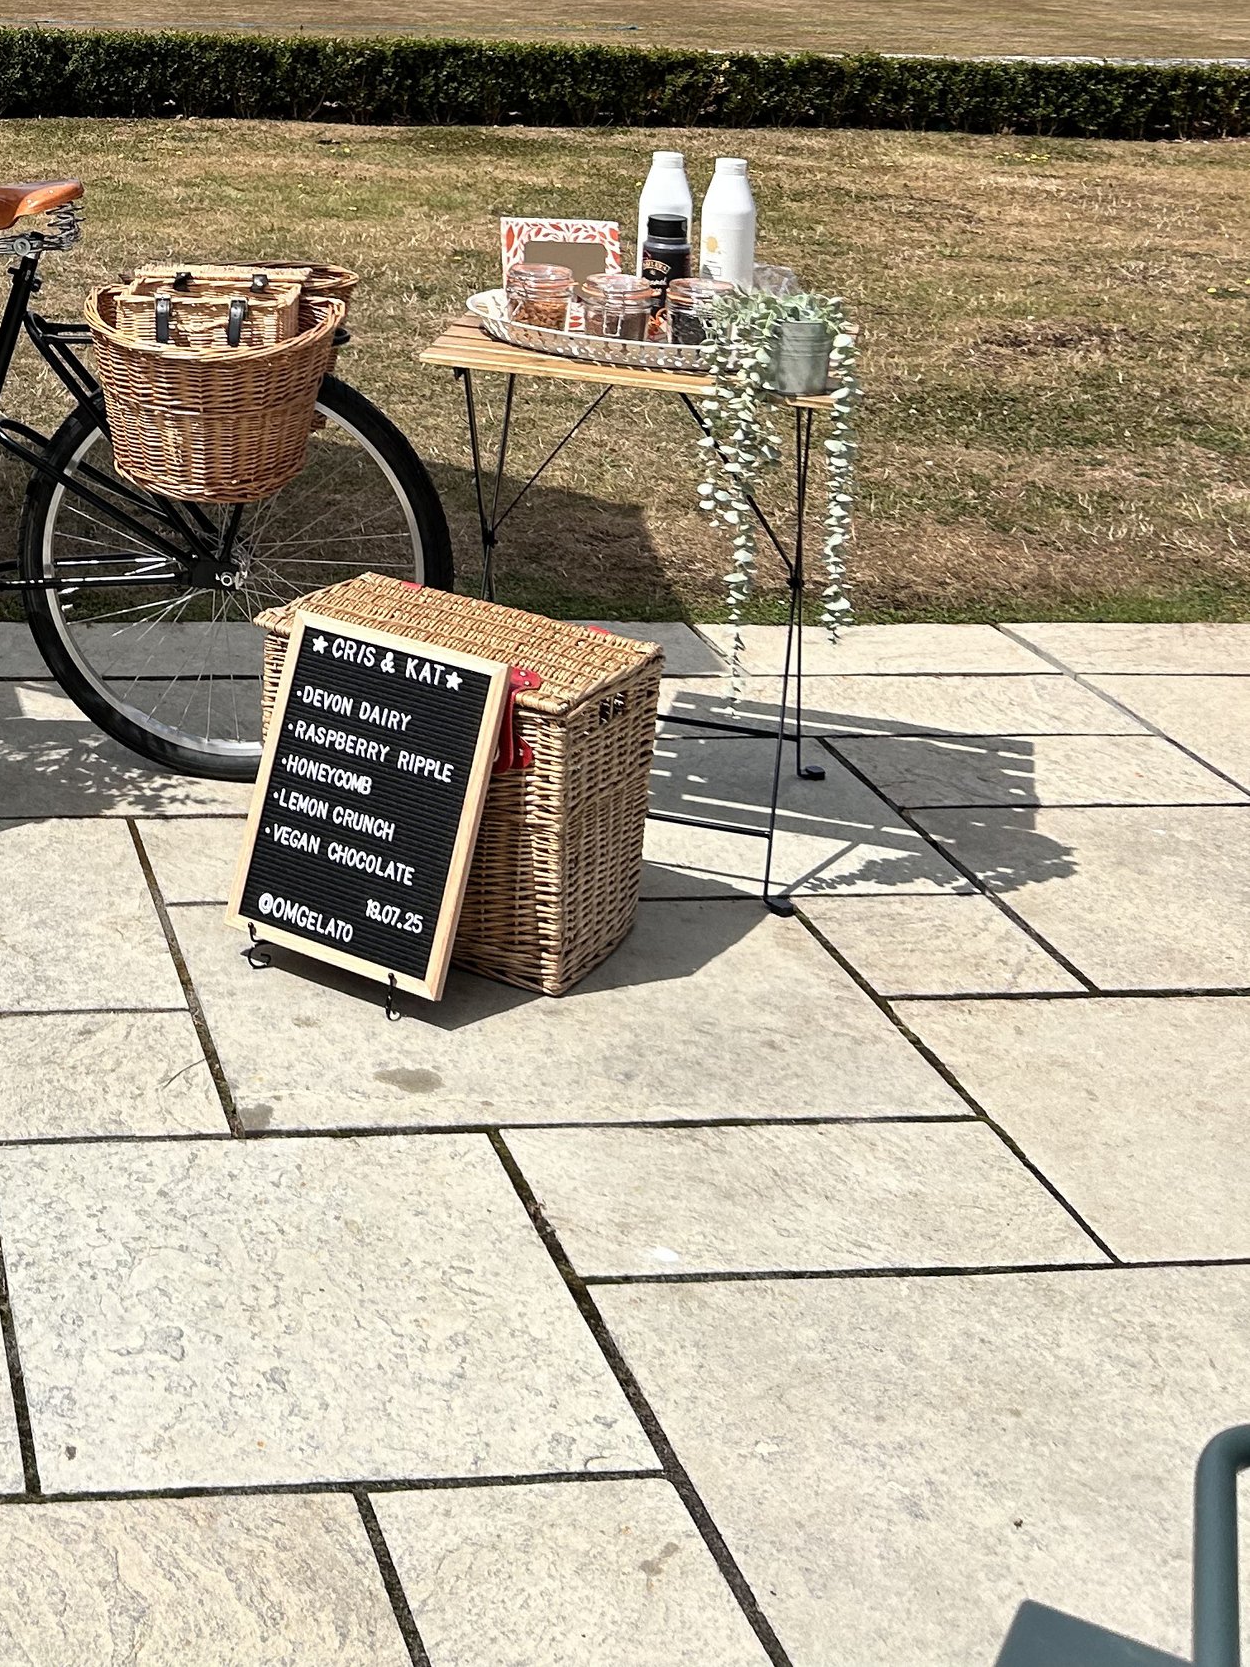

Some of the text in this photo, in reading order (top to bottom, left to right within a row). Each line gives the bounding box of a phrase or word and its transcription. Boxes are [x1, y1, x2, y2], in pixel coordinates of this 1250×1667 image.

[332, 638, 445, 685] CRIS & KAT
[303, 686, 411, 731] DEVON DAIRY
[287, 754, 372, 794] HONEYCOMB
[294, 720, 454, 782] RASPBERRY RIPPLE
[279, 788, 395, 841] LEMON CRUNCH
[274, 824, 414, 885] VEGAN CHOCOLATE
[259, 893, 353, 942] @OMGELATO
